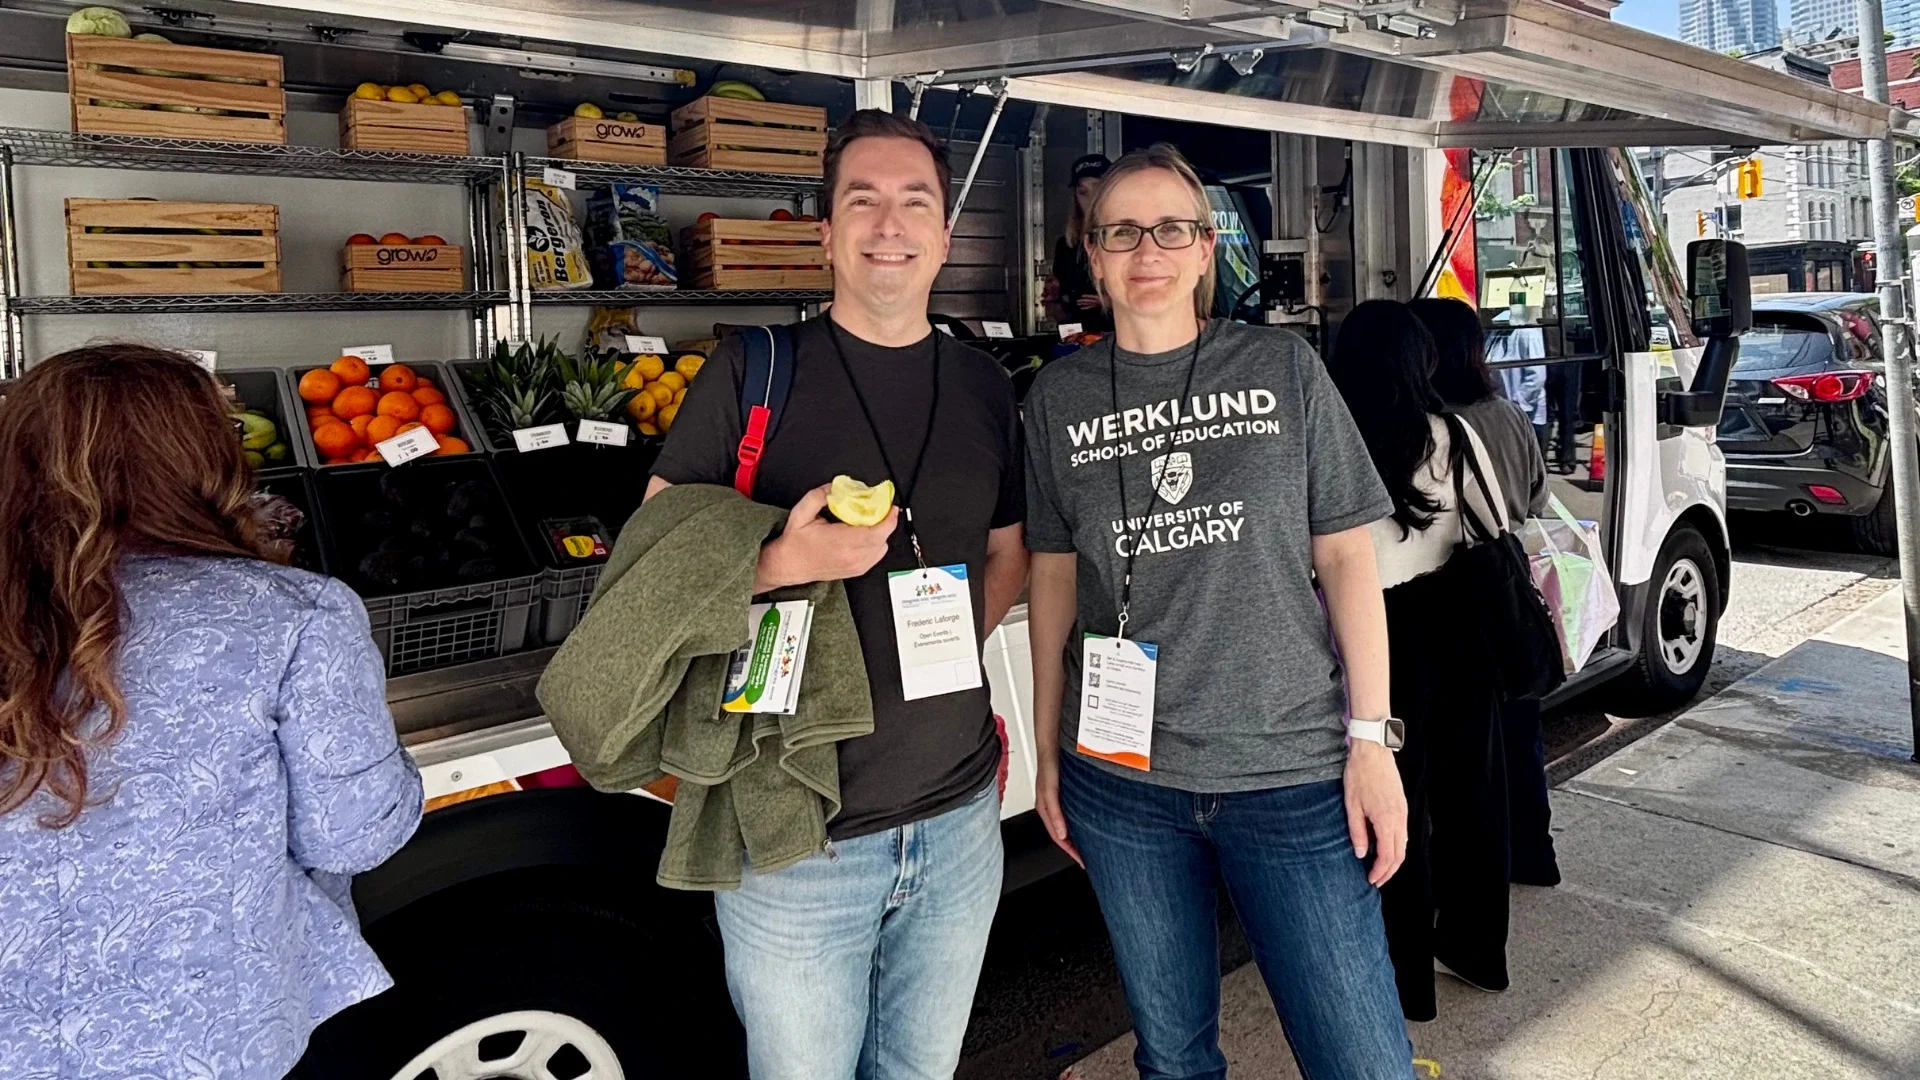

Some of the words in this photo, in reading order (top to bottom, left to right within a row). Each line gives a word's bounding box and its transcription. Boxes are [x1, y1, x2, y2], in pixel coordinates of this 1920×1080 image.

[536, 199, 569, 282] Bergeron
[1211, 210, 1244, 230] ROW
[1066, 389, 1277, 447] WERKLUND
[1070, 440, 1138, 467] SCHOOL
[1141, 434, 1166, 452] OF
[1170, 420, 1280, 446] EDUCATION
[1111, 504, 1213, 534] UNIVERSITY
[1218, 501, 1244, 516] OF
[1115, 517, 1245, 558] CALGARY
[907, 618, 933, 628] Frederic
[934, 614, 960, 624] Laforge
